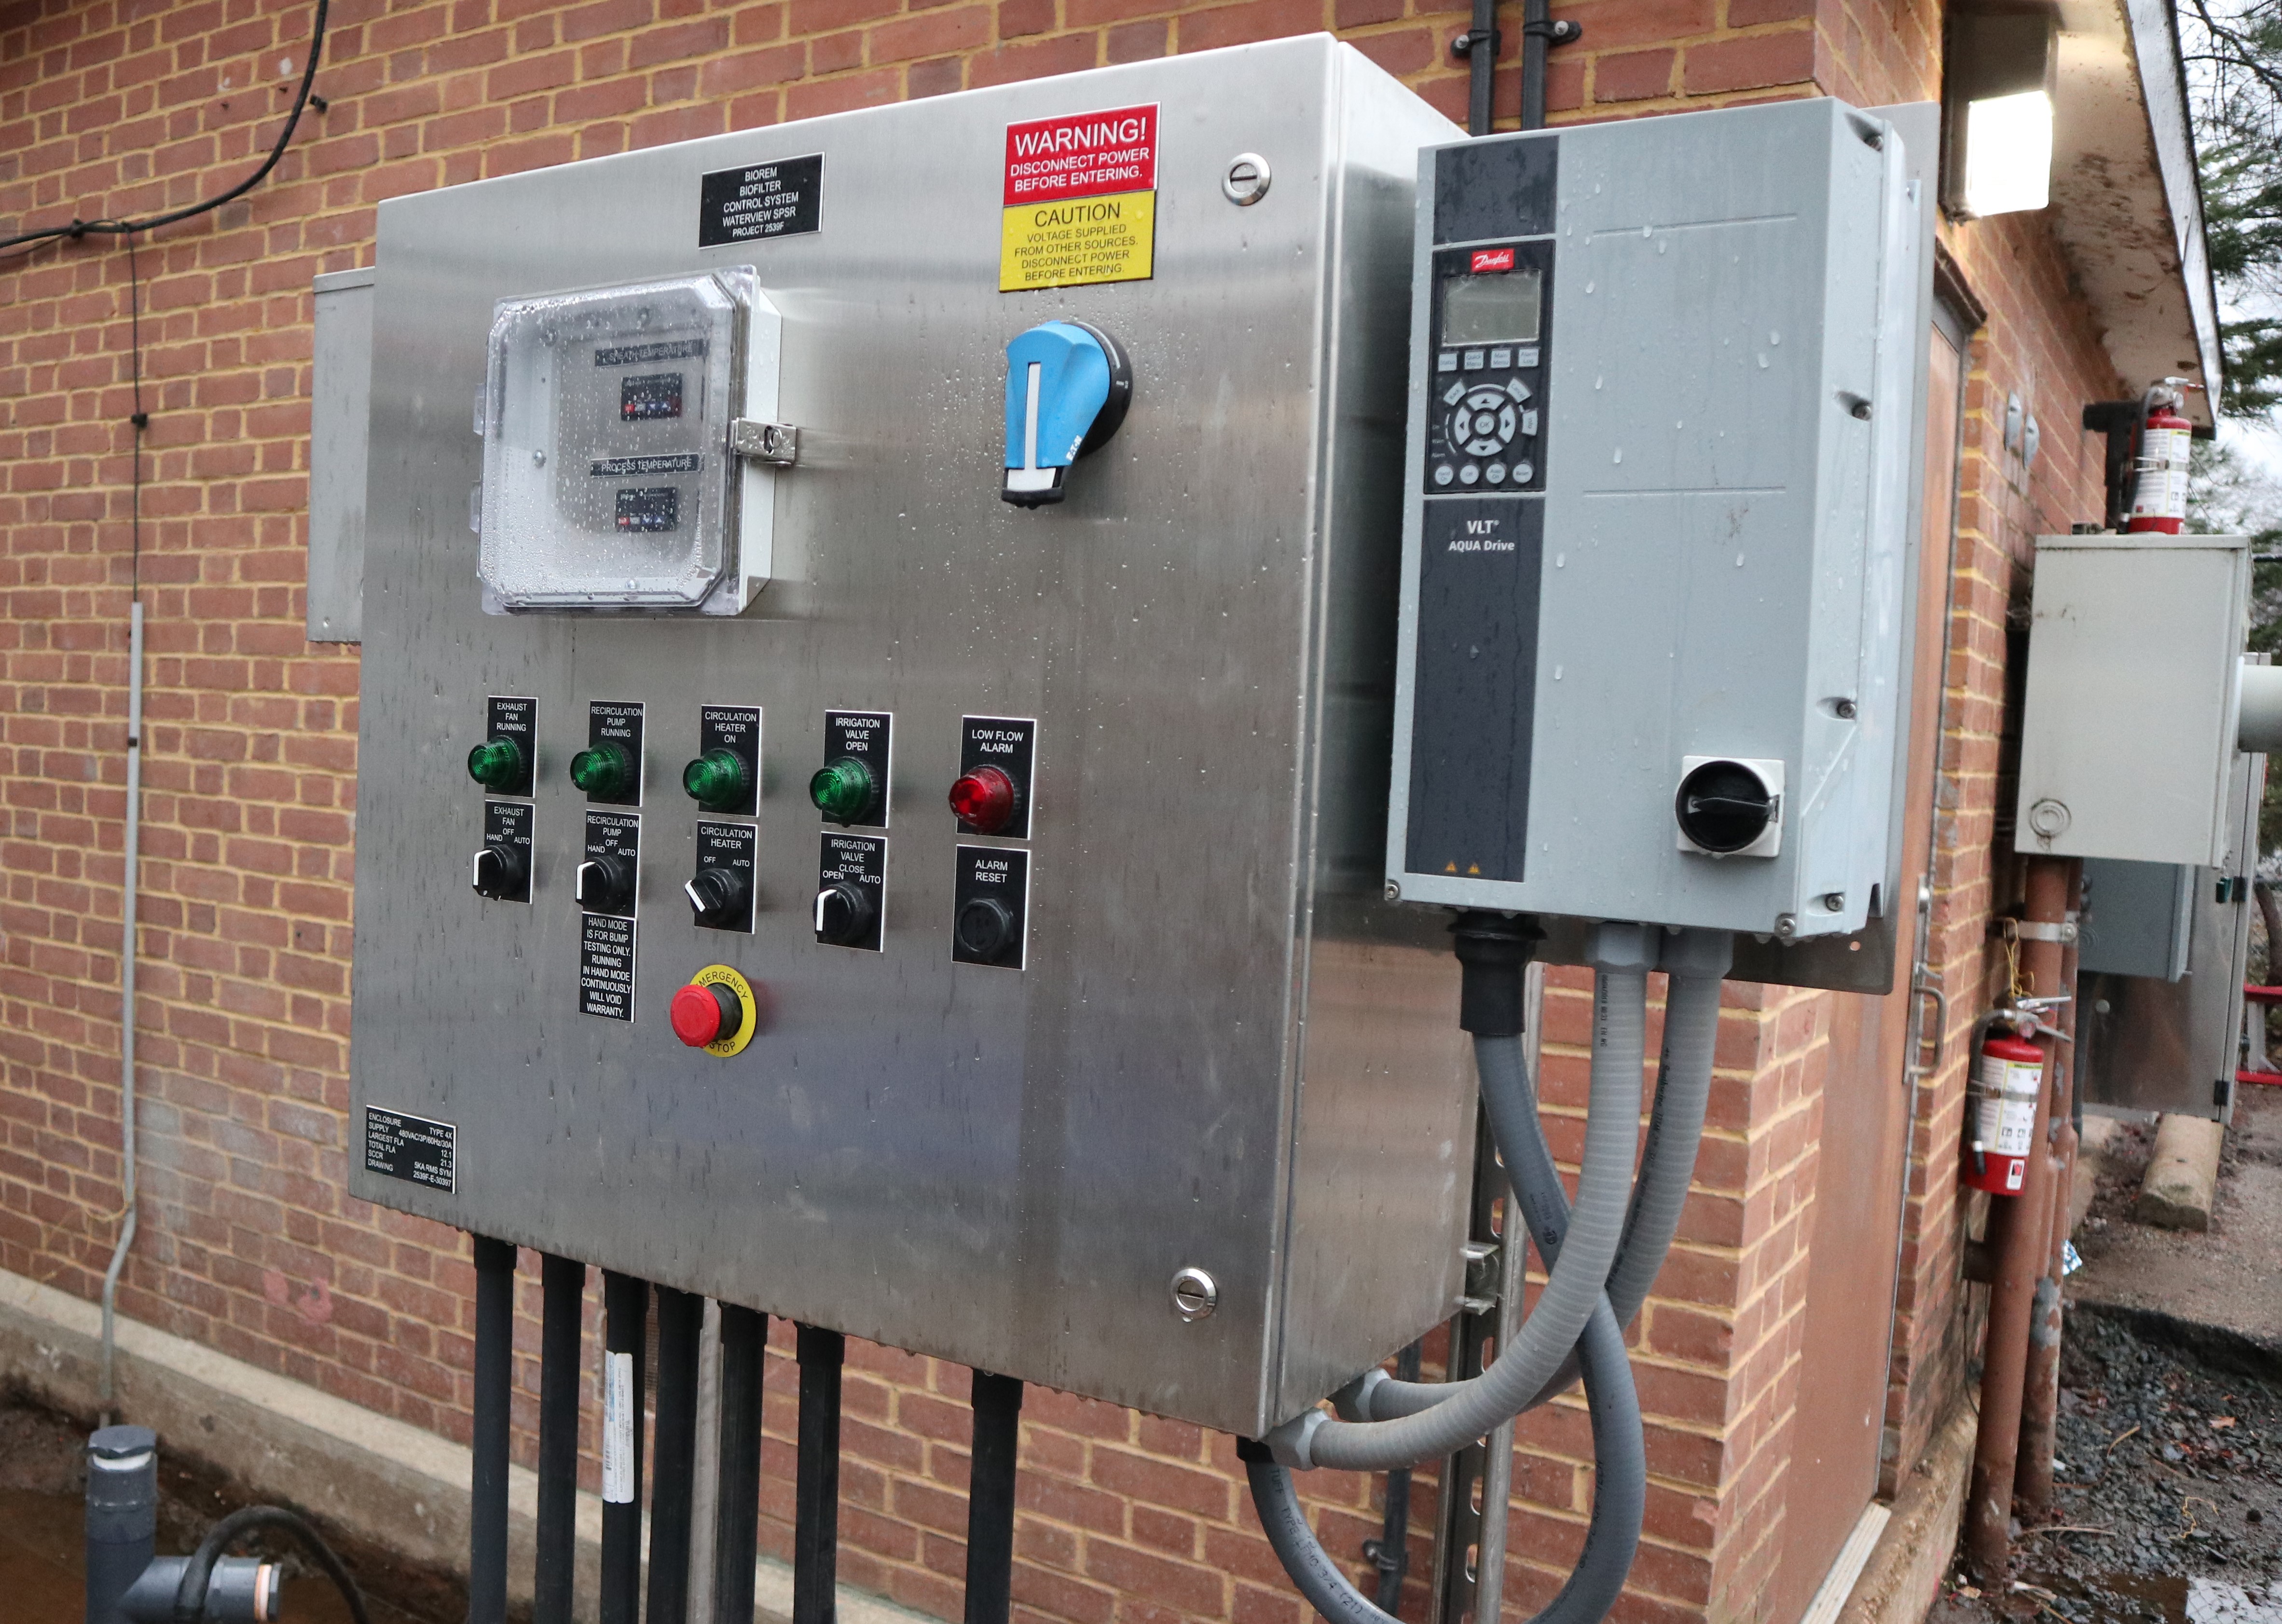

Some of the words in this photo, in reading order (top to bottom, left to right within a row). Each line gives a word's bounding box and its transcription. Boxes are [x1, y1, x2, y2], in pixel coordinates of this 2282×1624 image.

[1015, 117, 1146, 156] WARNING!
[1010, 154, 1095, 176] DISCONNECT
[1098, 147, 1149, 165] POWER
[745, 167, 777, 181] BIOREM
[1015, 174, 1067, 192] BEFORE
[1071, 165, 1142, 185] ENTERING.
[740, 180, 781, 196] BIOFILTER
[724, 197, 763, 213] CONTROL
[765, 191, 799, 207] SYSTEM
[723, 210, 771, 227] WATERVIEW
[773, 206, 796, 219] SPSR
[1035, 202, 1120, 227] CAUTION
[733, 224, 764, 237] PROJECT
[765, 221, 784, 232] 2539F
[1028, 230, 1072, 243] VOLTAGE
[1075, 224, 1126, 238] SUPPLIED
[1015, 246, 1043, 257] FROM
[1046, 242, 1081, 253] OTHER
[1085, 236, 1138, 249] SOURCES.
[1022, 253, 1086, 268] DISCONNECT
[1090, 250, 1129, 261] POWER
[1474, 252, 1509, 268] Danfoss
[1025, 269, 1065, 281] BEFORE
[1069, 263, 1124, 276] ENTERING.
[639, 345, 693, 357] TEMPERATURE
[602, 462, 635, 473] PROCESS
[638, 459, 692, 470] TEMPERATURE
[1449, 540, 1481, 553] AQUA
[1484, 539, 1515, 551] Drive
[497, 703, 527, 711] EXHAUST
[591, 706, 643, 716] RECIRCULATION
[607, 718, 626, 726] PUMP
[705, 712, 757, 722] CIRCULATION
[836, 717, 880, 728] IRRIGATION
[496, 723, 526, 731] RUNNING
[601, 728, 631, 737] RUNNING
[715, 723, 746, 733] HEATER
[724, 735, 736, 743] ON
[845, 730, 869, 740] VALVE
[972, 729, 993, 740] LOW
[996, 731, 1023, 741] FLOW
[846, 742, 868, 751] OPEN
[980, 743, 1013, 753] ALARM
[494, 806, 524, 817] EXHAUST
[502, 818, 515, 826] FAN
[587, 816, 638, 828] RECIRCULATION
[603, 827, 621, 836] PUMP
[701, 826, 753, 839] CIRCULATION
[486, 833, 503, 842] HAND
[514, 836, 530, 845] AUTO
[711, 838, 742, 849] HEATER
[831, 839, 875, 851] IRRIGATION
[588, 845, 605, 854] HAND
[618, 848, 636, 857] AUTO
[840, 852, 864, 862] VALVE
[703, 856, 716, 864] OFF
[732, 859, 750, 867] AUTO
[976, 860, 1008, 871] ALARM
[839, 864, 865, 874] CLOSE
[823, 871, 844, 880] OPEN
[859, 875, 881, 884] AUTO
[976, 872, 1007, 883] RESET
[588, 917, 607, 928] HAND
[608, 920, 627, 931] MODE
[587, 929, 593, 938] IS
[594, 930, 608, 940] FOR
[609, 932, 628, 943] BUMP
[584, 941, 611, 953] TESTING
[612, 945, 631, 957] ONLY.
[591, 955, 622, 968] RUNNING
[583, 966, 590, 974] IN
[591, 967, 609, 978] HAND
[610, 970, 630, 982] MODE
[581, 977, 631, 994] CONTINUOUSLY
[697, 971, 748, 999] MERGENCY
[590, 991, 605, 1002] WILL
[605, 993, 622, 1005] VOID
[587, 1003, 624, 1018] WARRANTY.
[368, 1122, 389, 1133] SUPPLY
[369, 1112, 401, 1127] ENCLOSURE
[429, 1127, 444, 1137] TYPE
[368, 1131, 393, 1143] LARGEST
[394, 1137, 404, 1146] FLA
[441, 1149, 452, 1159] 12.1
[368, 1140, 385, 1151] TOTAL
[385, 1145, 396, 1154] FLA
[440, 1159, 452, 1168] 21.3
[368, 1149, 383, 1160] SCCR
[414, 1161, 425, 1171] 5KA
[426, 1164, 438, 1174] RMS
[439, 1168, 452, 1178] SYM
[368, 1159, 393, 1172] DRAWING
[1282, 1507, 1299, 1535] TYPE
[1340, 1593, 1363, 1614] (21)
